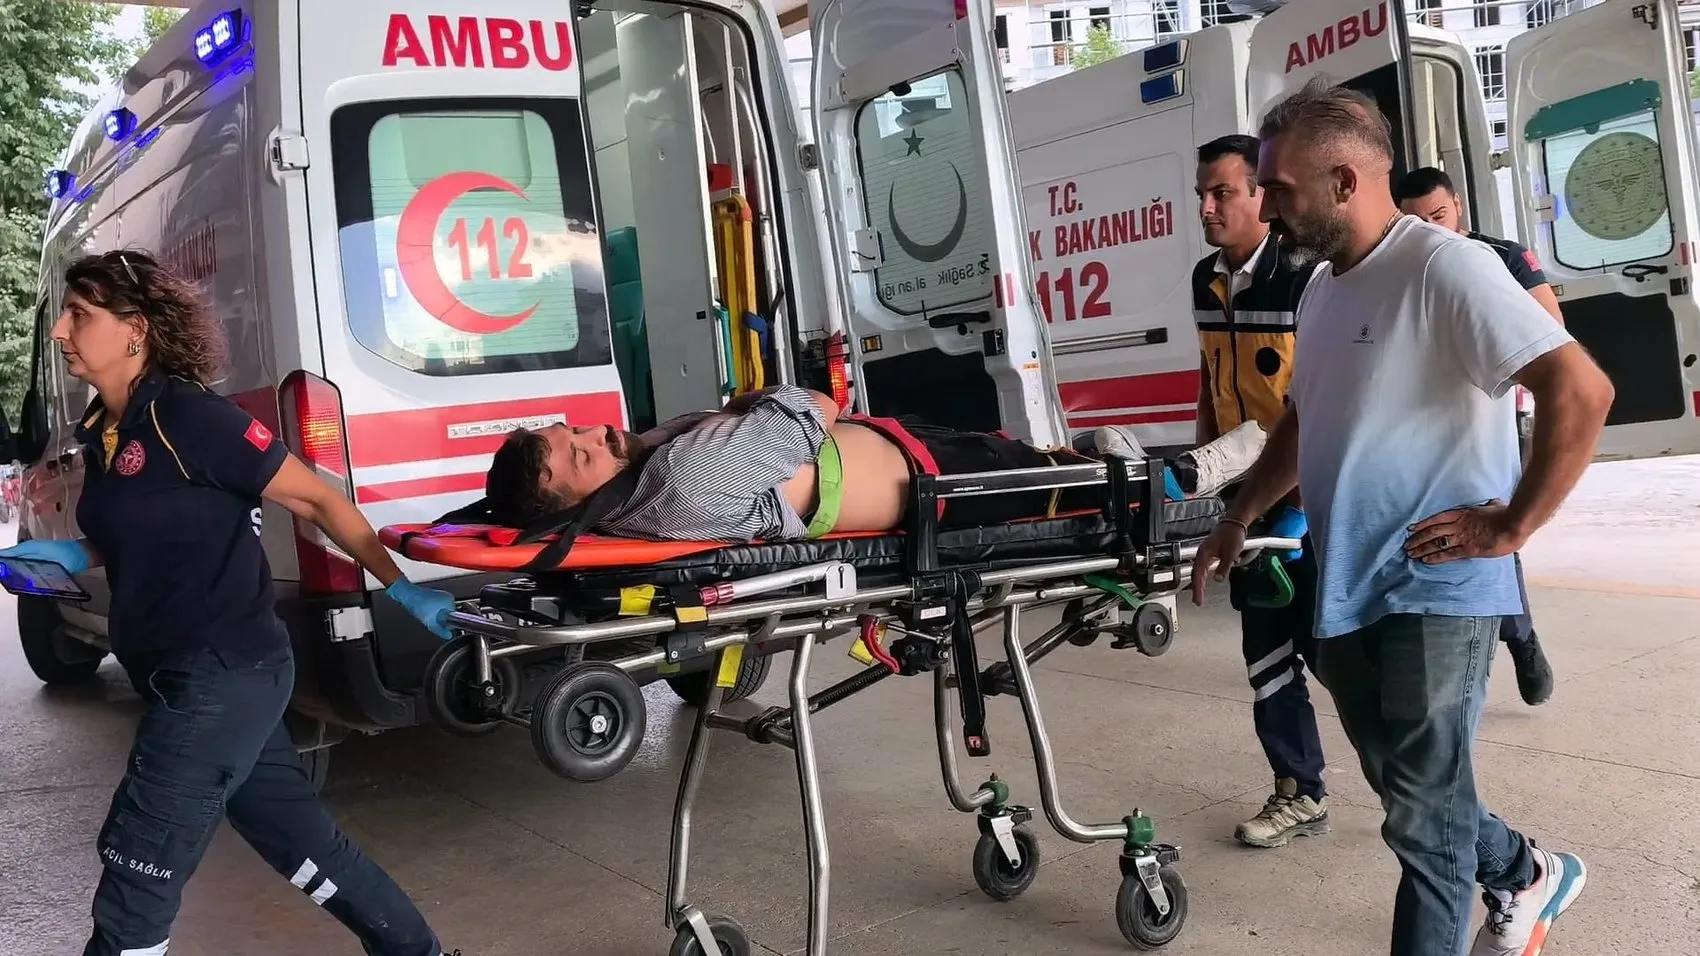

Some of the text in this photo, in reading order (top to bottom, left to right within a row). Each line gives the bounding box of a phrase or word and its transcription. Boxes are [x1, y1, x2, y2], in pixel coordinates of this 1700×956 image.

[382, 14, 572, 71] AMBU
[1285, 1, 1387, 74] AMBU
[1048, 181, 1083, 217] T.C.
[1055, 196, 1173, 257] BAKANLIĞI
[448, 216, 532, 281] 112
[1036, 261, 1112, 323] 112
[129, 858, 173, 879] SAĞLIK
